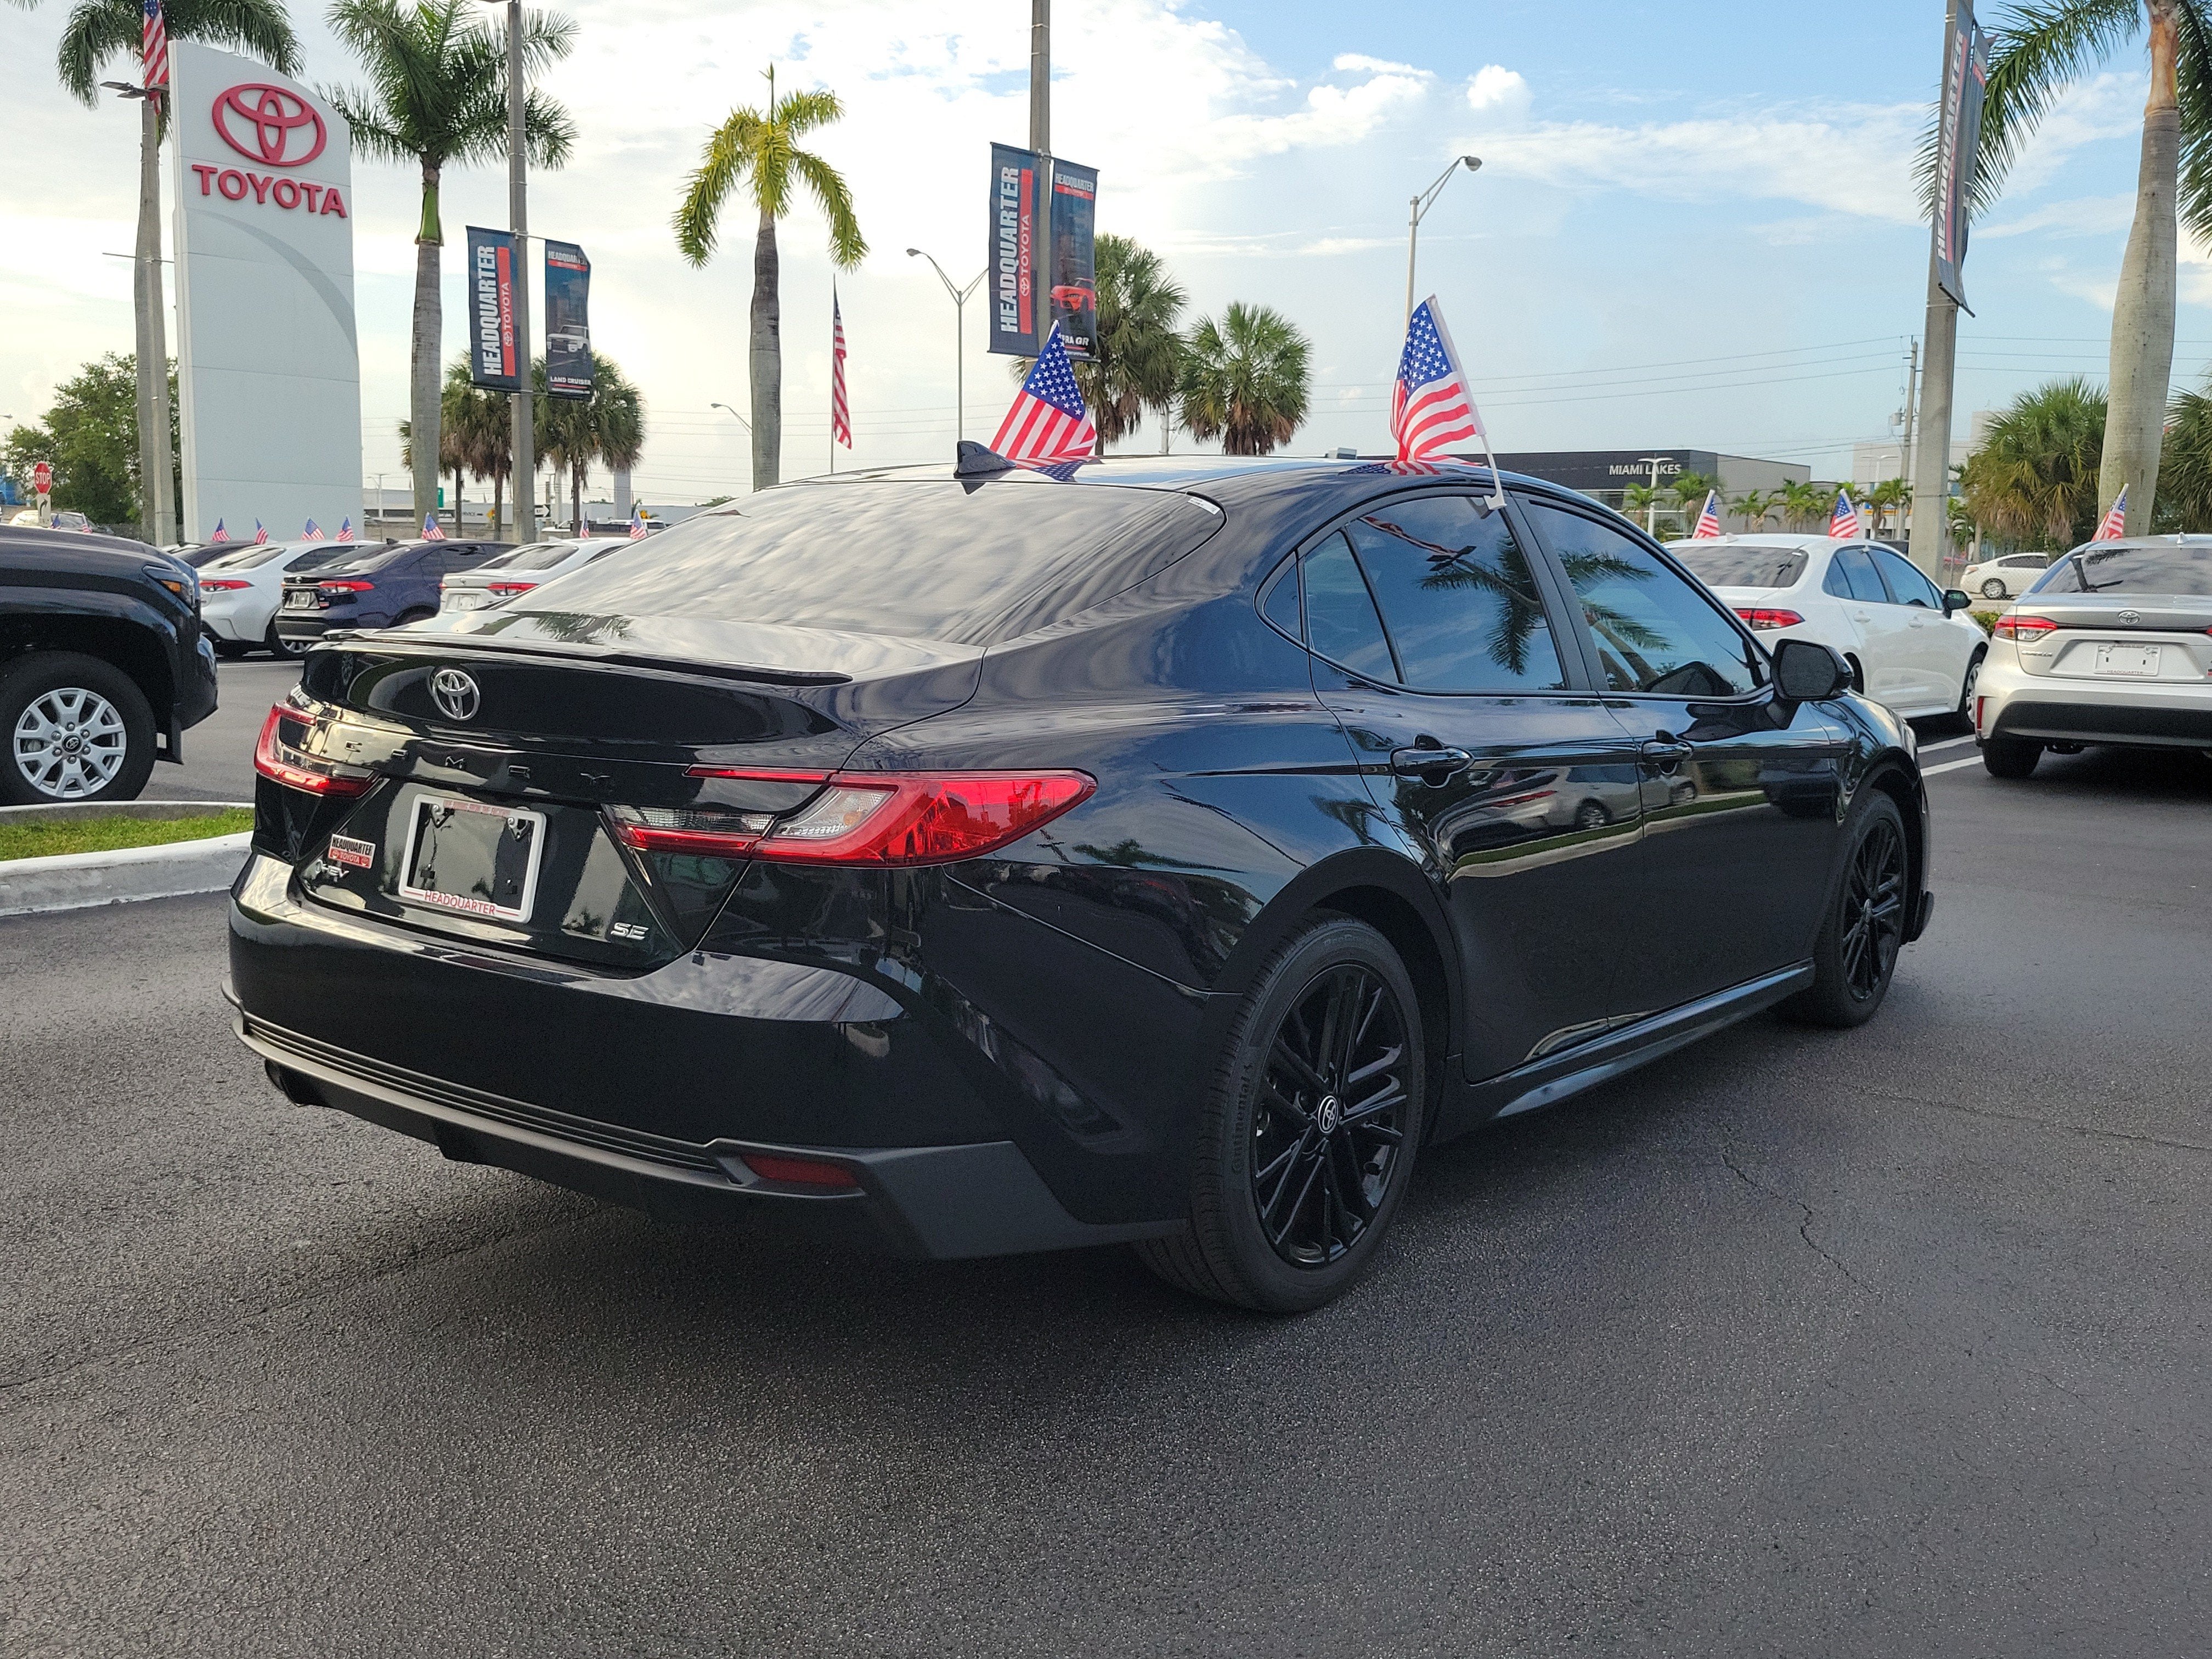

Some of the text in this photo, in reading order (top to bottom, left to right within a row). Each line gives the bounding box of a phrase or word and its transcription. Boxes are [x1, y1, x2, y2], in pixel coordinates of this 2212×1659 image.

[1937, 29, 1963, 261] HEADQUARTER
[191, 164, 348, 219] TOYOTA
[999, 166, 1019, 333] HEADQUARTER
[1021, 215, 1030, 276] TOYOTA
[477, 245, 503, 376] HEADQUARTER
[500, 282, 514, 330] TOYOTA
[1075, 336, 1090, 346] GR
[36, 472, 50, 484] STOP
[1609, 465, 1643, 475] MIAMI
[331, 837, 373, 856] HEADQUARTER
[340, 852, 360, 864] TOYOTA
[425, 890, 496, 915] HEADQUARTER
[611, 922, 649, 940] SE
